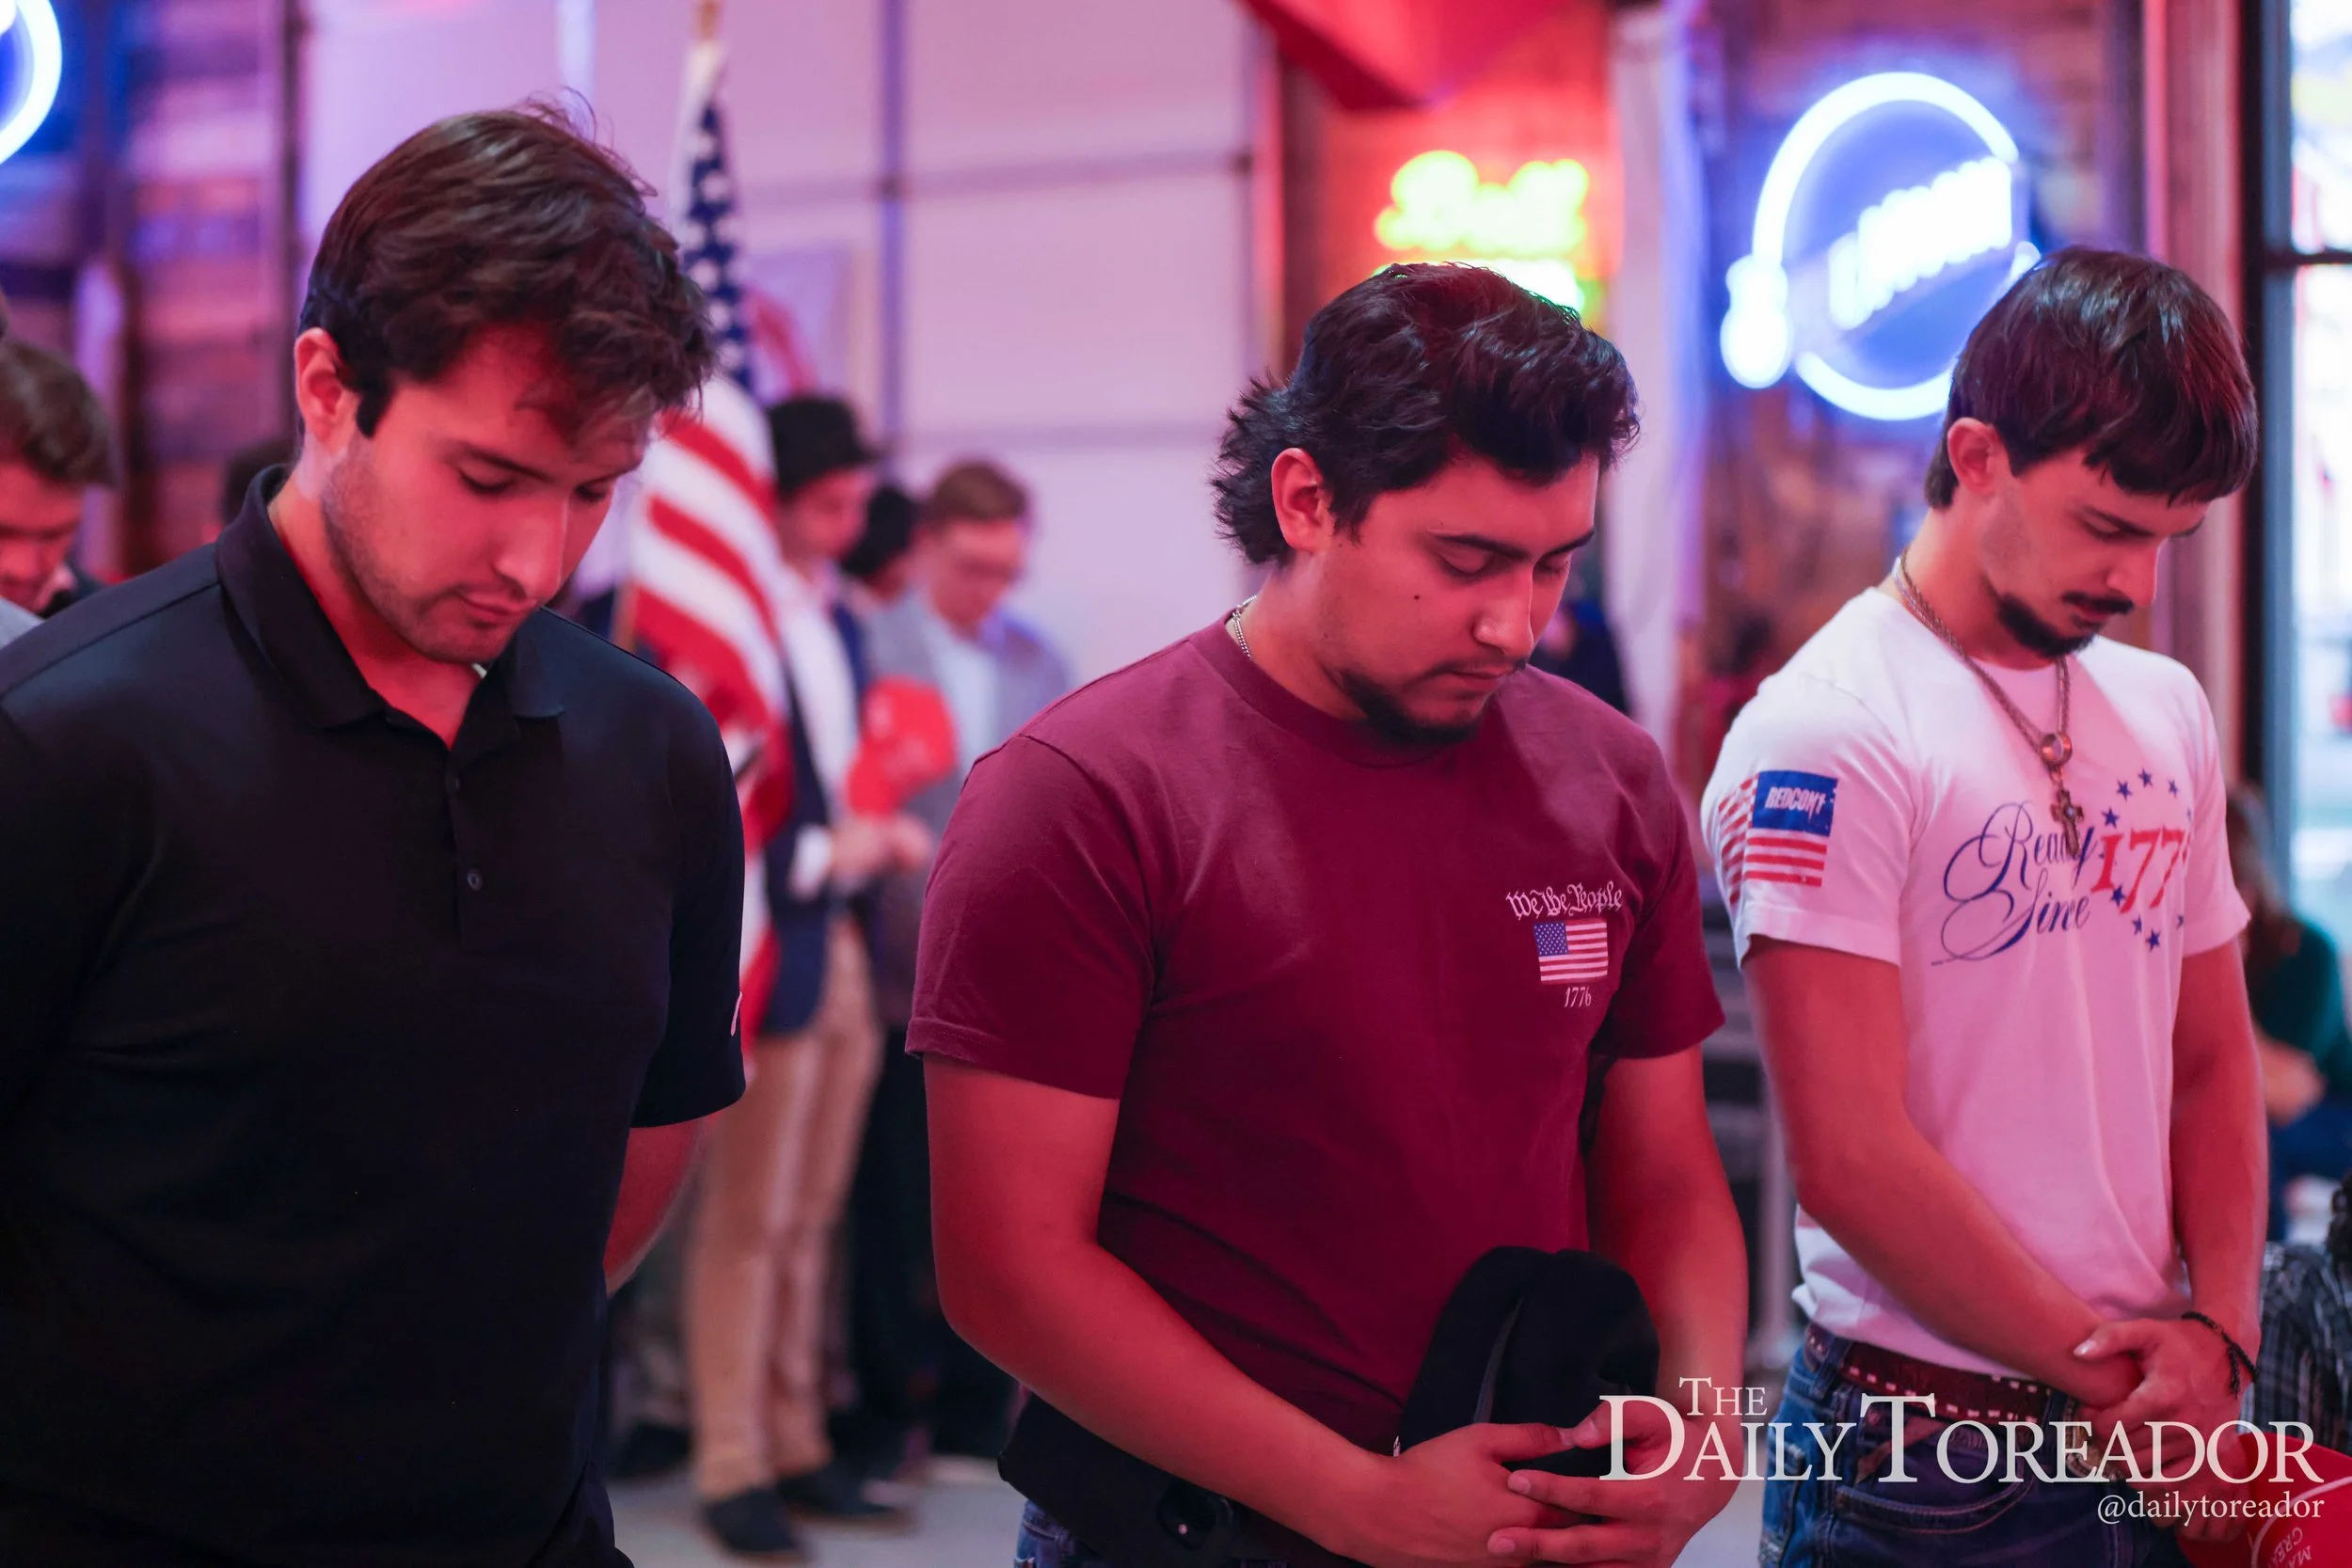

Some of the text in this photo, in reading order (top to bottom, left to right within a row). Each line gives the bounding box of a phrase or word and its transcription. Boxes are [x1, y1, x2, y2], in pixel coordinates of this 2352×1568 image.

[2090, 825, 2191, 915] 177
[1505, 890, 1544, 920] We
[1566, 880, 1623, 916] People
[1564, 987, 1592, 1007] 1776
